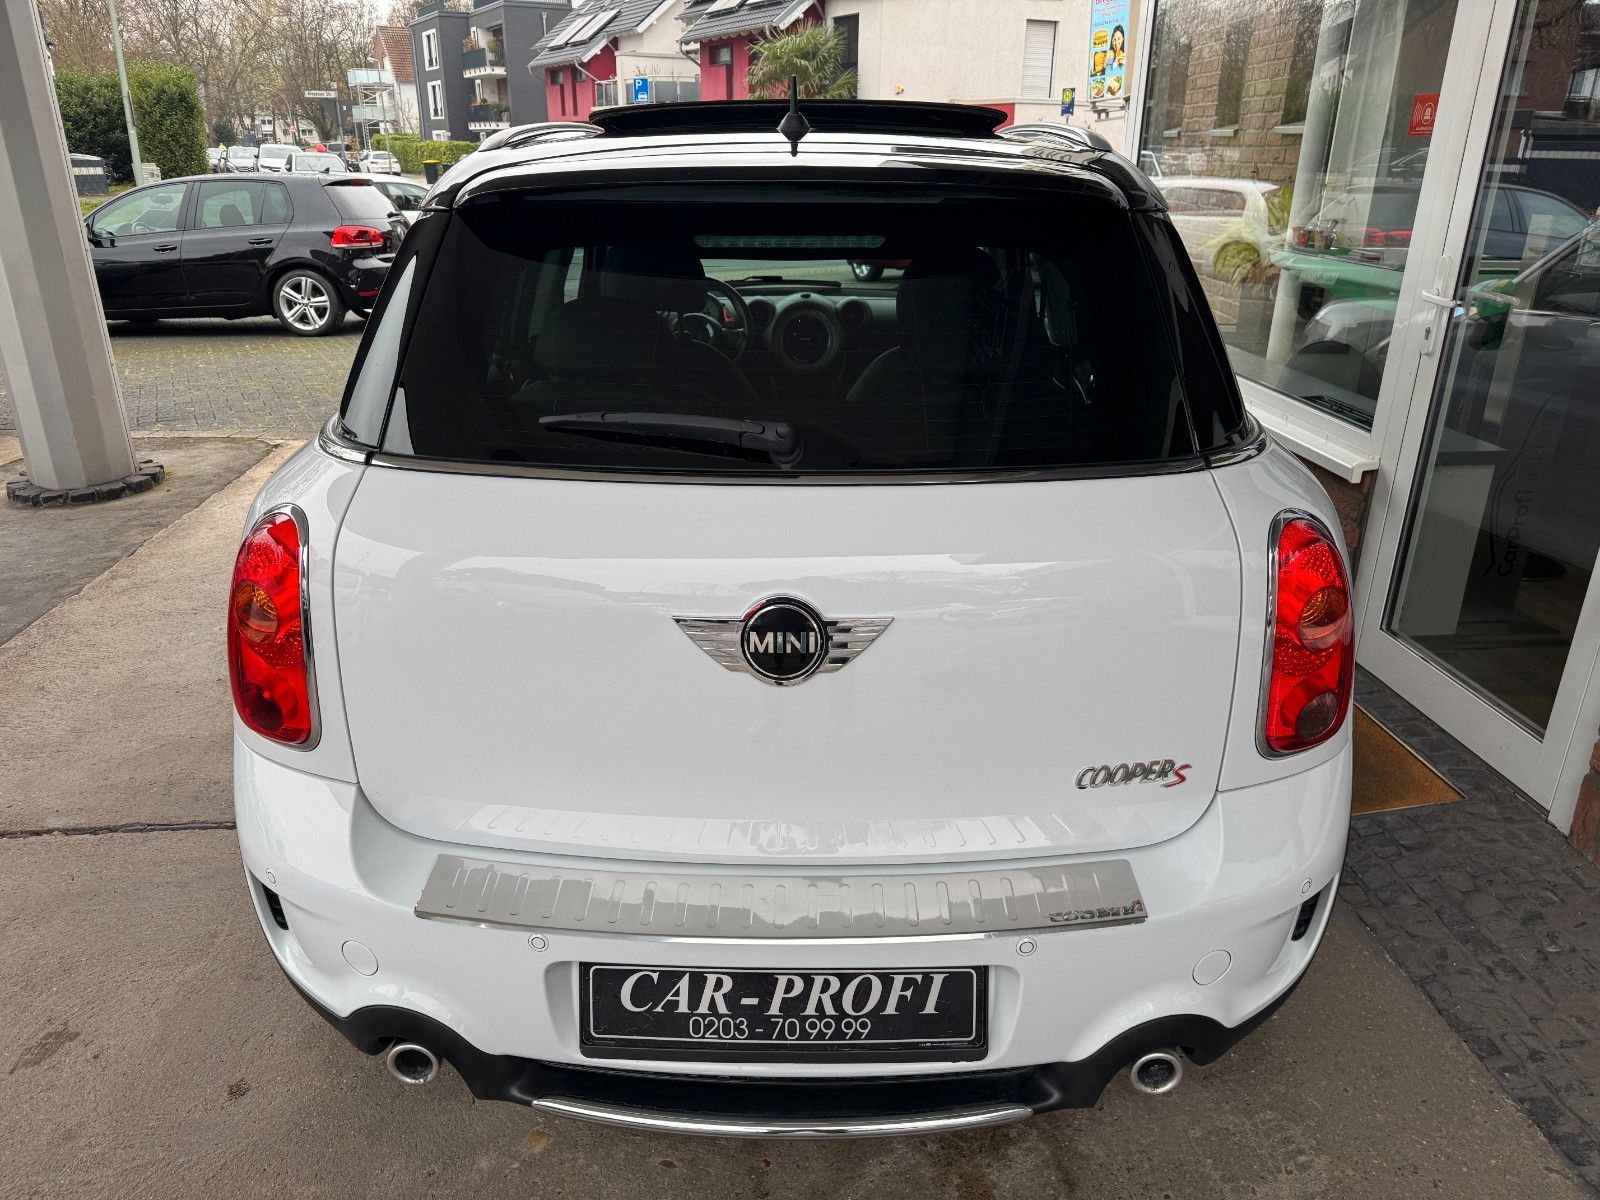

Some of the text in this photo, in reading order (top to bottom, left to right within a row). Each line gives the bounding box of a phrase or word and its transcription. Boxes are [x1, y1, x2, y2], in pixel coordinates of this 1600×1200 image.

[635, 79, 642, 90] P
[749, 631, 816, 654] MINI
[1075, 759, 1192, 790] COOPER S
[689, 1016, 749, 1040] 0203
[770, 1017, 800, 1040] 70
